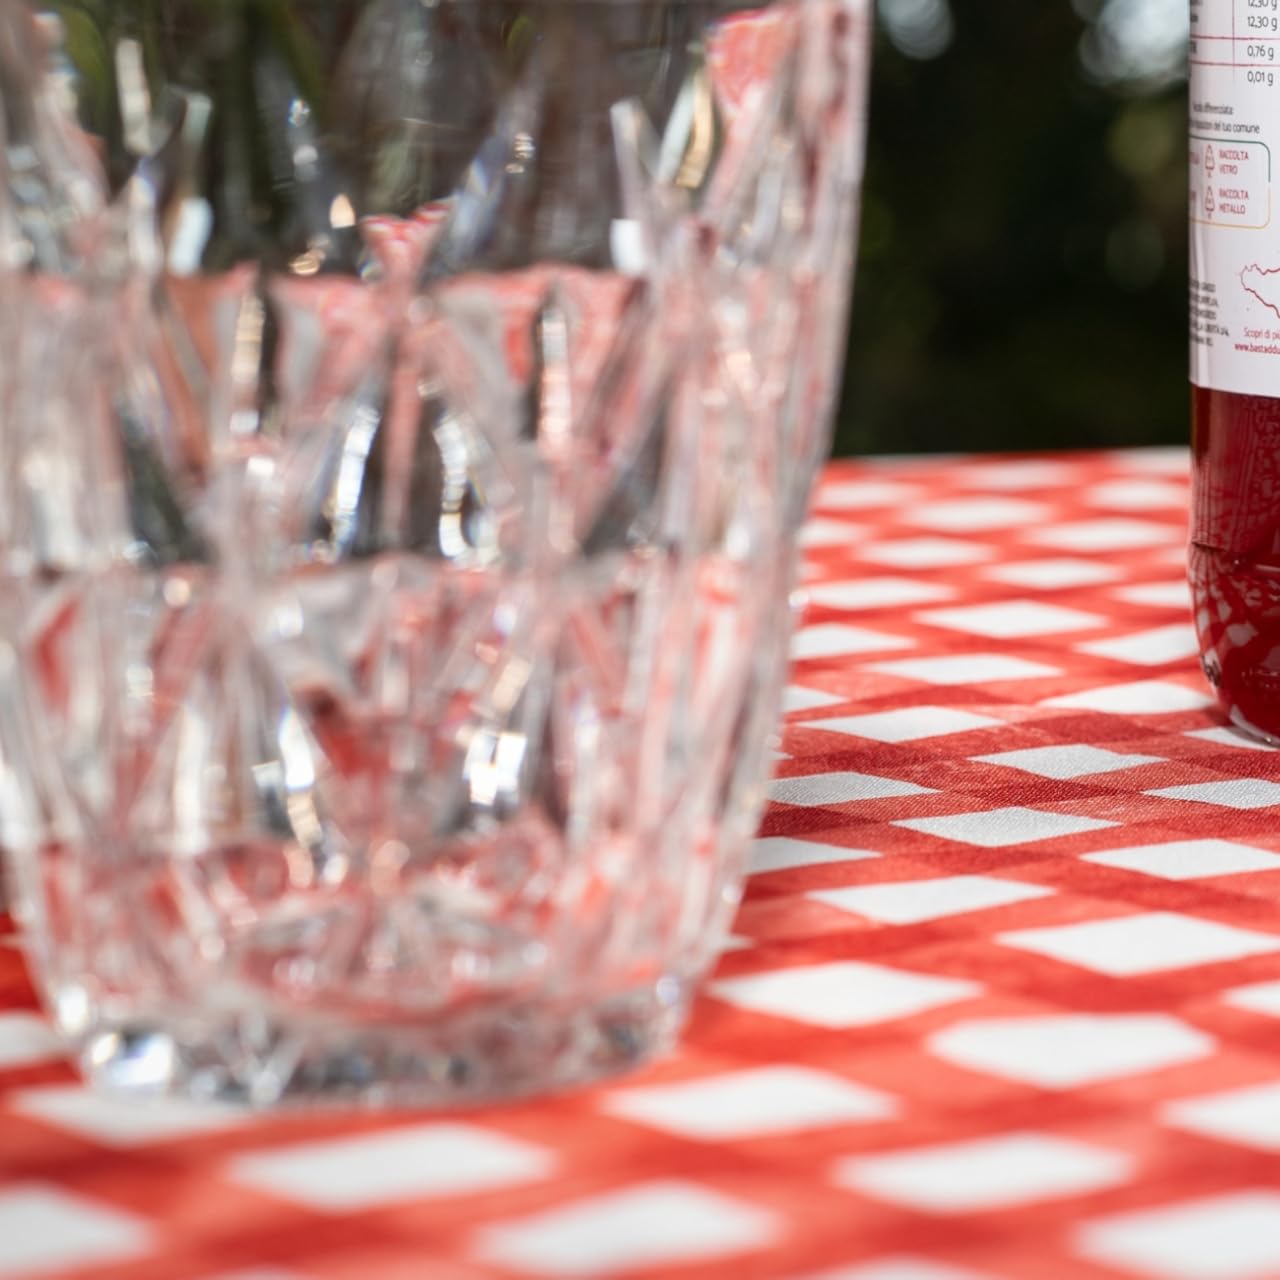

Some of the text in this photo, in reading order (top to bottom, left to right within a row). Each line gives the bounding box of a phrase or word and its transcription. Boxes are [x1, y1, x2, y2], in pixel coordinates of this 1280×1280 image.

[1271, 18, 1277, 31] g
[1267, 47, 1274, 60] g
[1247, 71, 1274, 86] 0,01 g
[1233, 123, 1260, 134] comune
